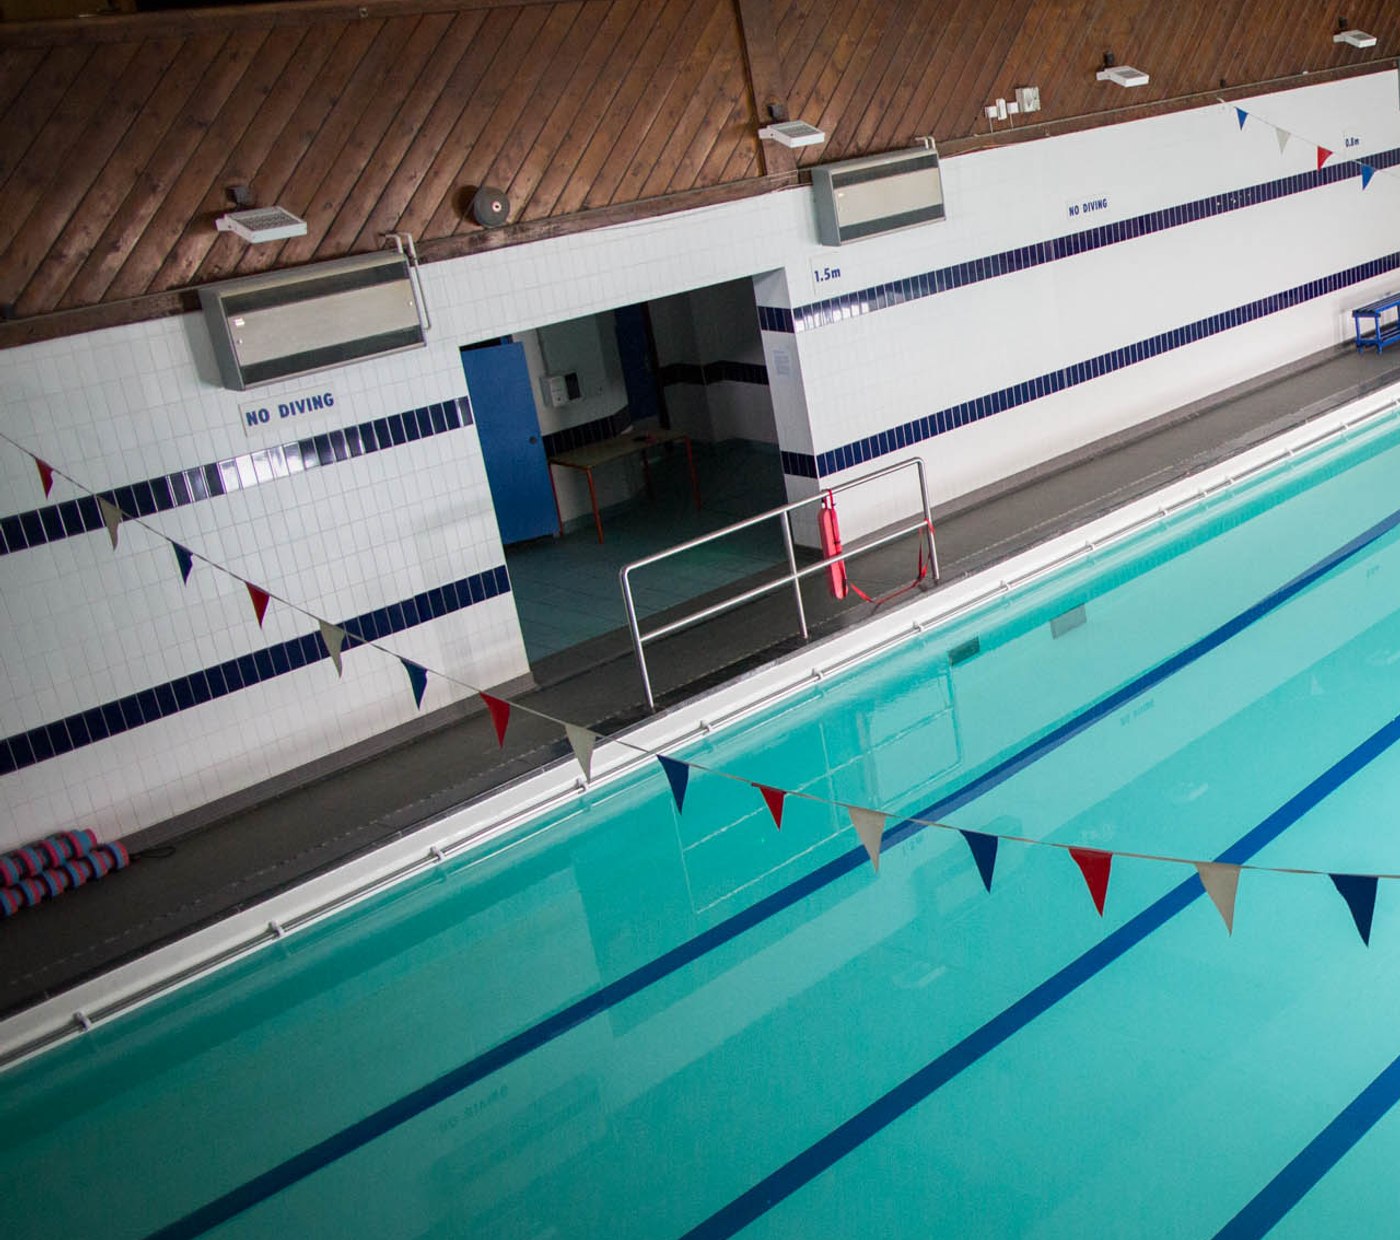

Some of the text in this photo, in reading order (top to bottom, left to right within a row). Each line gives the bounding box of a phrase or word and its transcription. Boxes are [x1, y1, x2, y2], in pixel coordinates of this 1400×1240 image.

[1068, 198, 1108, 216] NO DIVING
[814, 267, 841, 282] 1.5m
[245, 392, 335, 427] NO DIVING
